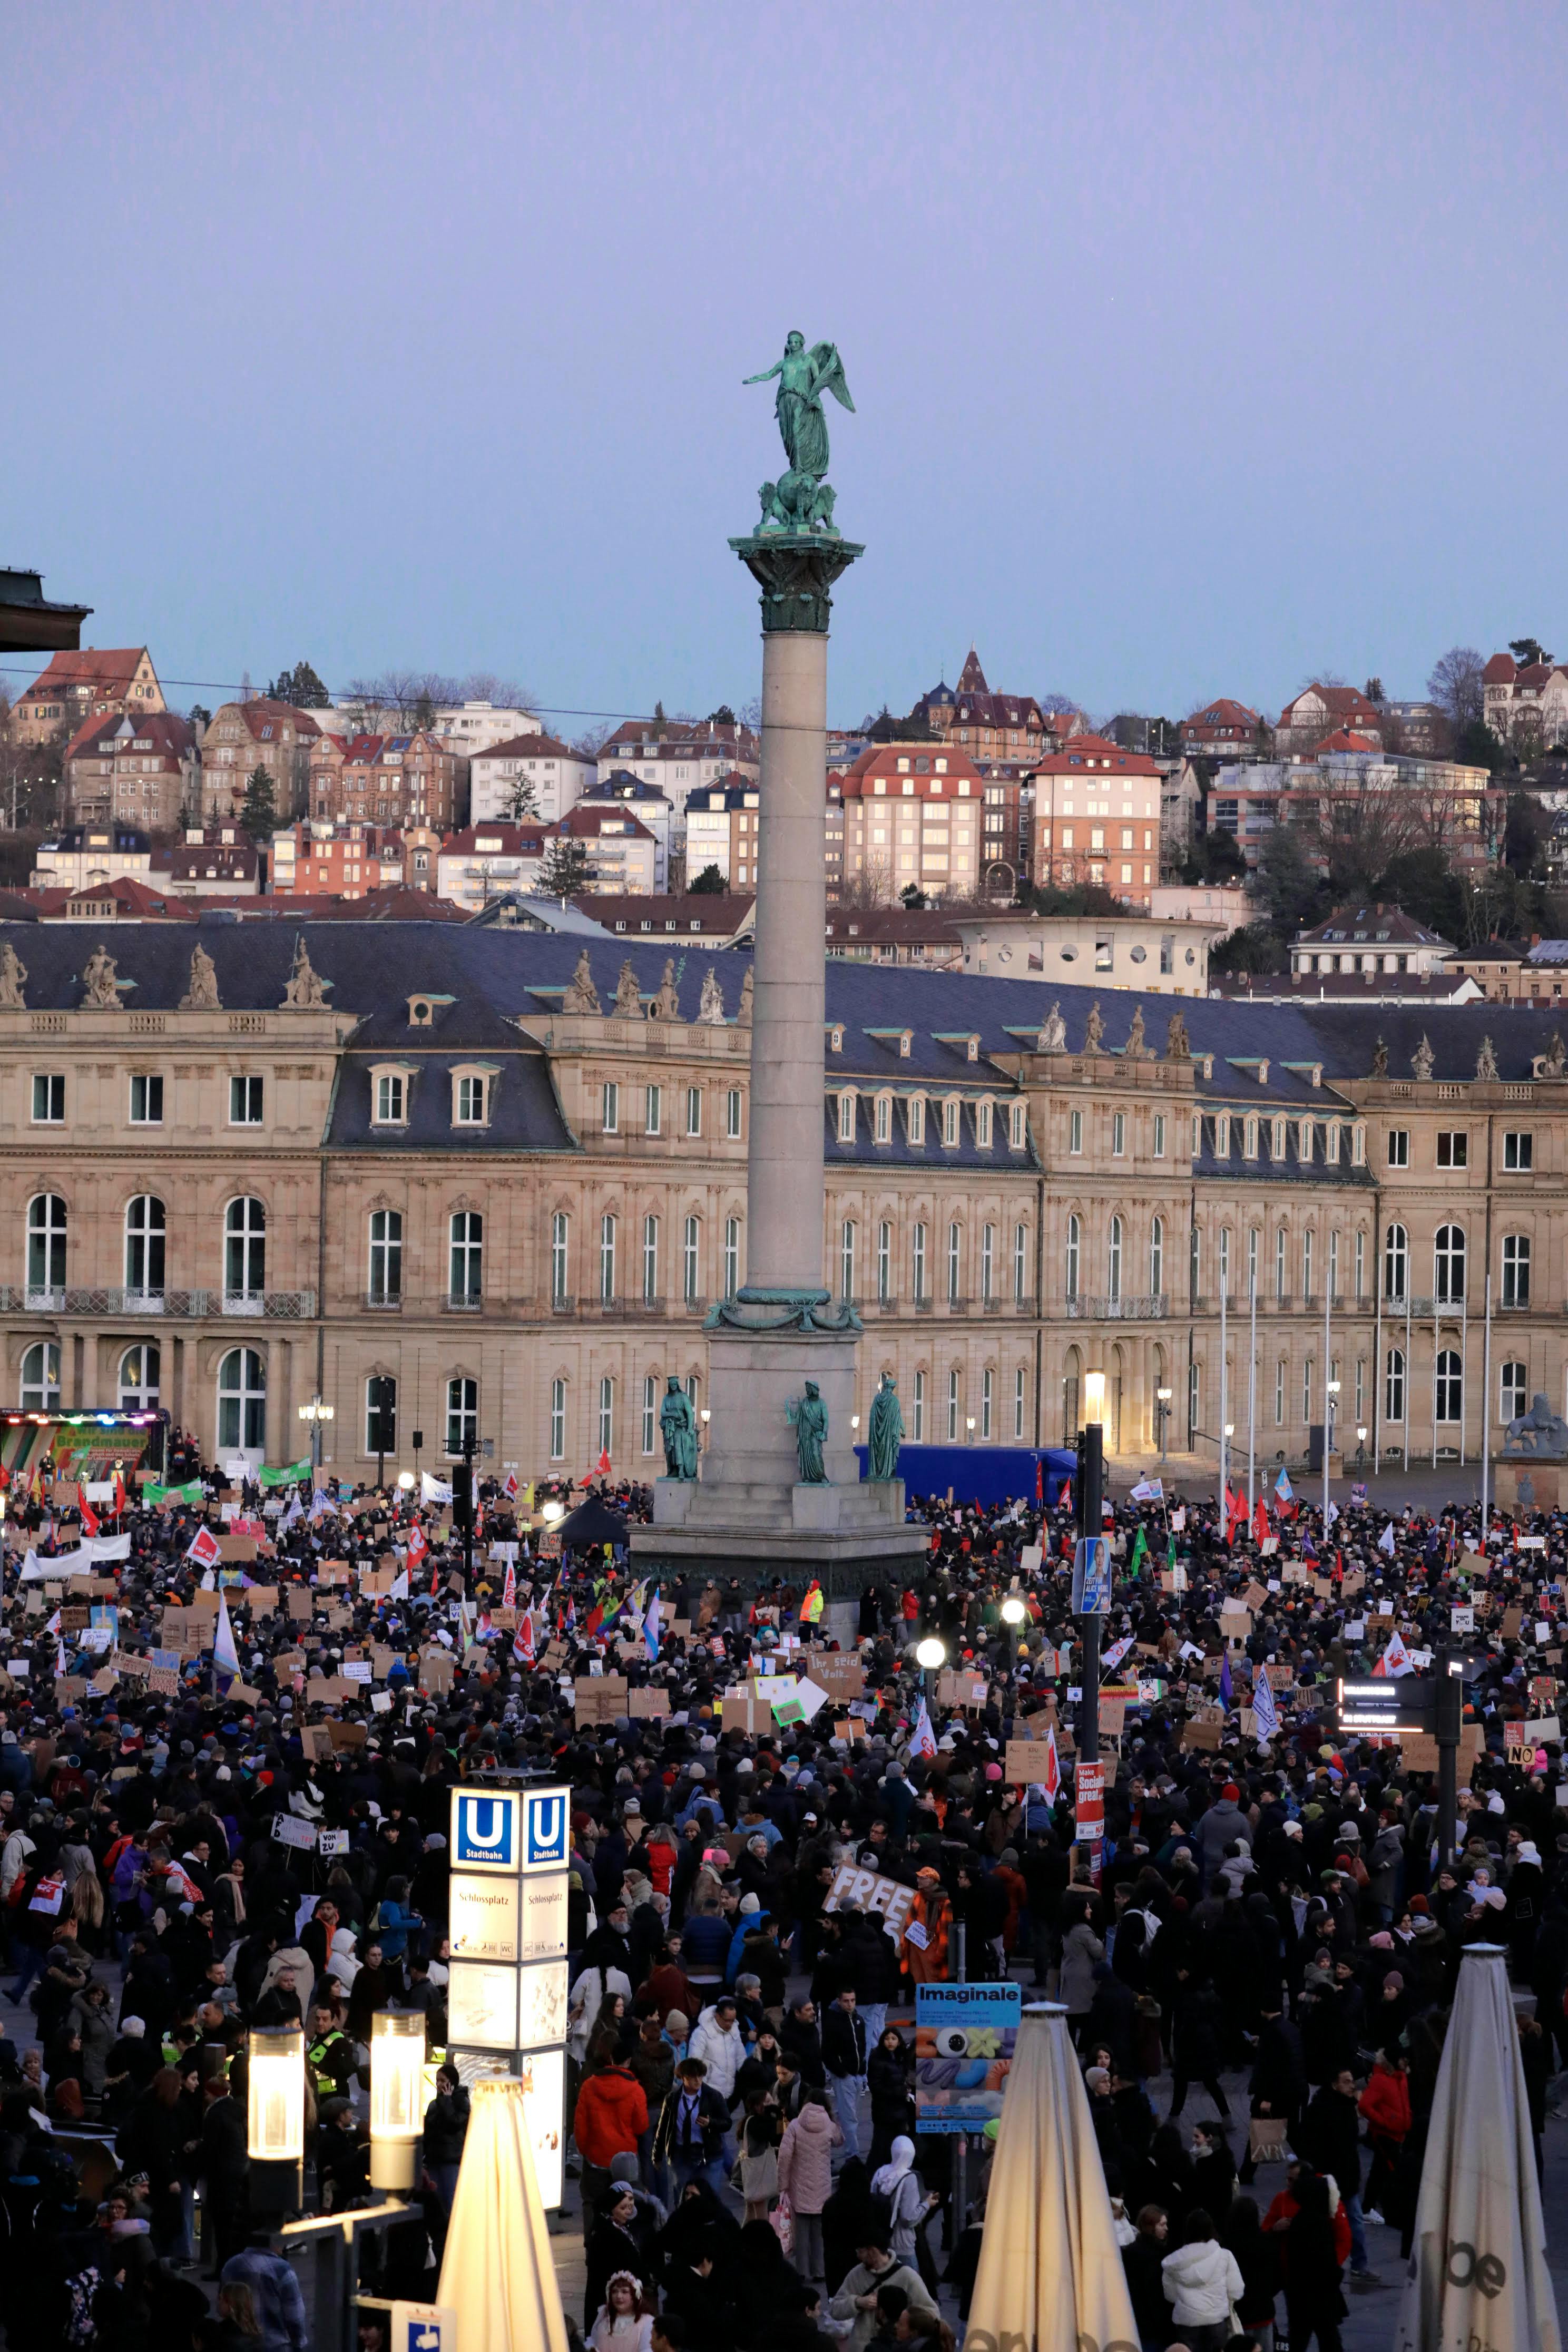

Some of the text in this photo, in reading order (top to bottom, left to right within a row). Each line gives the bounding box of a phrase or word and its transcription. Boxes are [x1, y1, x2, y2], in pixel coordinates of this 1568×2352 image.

[57, 1436, 146, 1447] Brandmauer
[811, 1654, 827, 1669] Ihr
[152, 1668, 177, 1677] SCHADEN
[1511, 1746, 1532, 1763] NO
[1079, 1789, 1099, 1804] great
[466, 1799, 503, 1848] U
[534, 1799, 560, 1847] U
[322, 1843, 334, 1851] ZU
[466, 1848, 503, 1860] Stadtbahn
[533, 1850, 559, 1860] Stadtbahn
[459, 1892, 509, 1906] Schlossplatz
[528, 1893, 563, 1905] Schlossplatz
[834, 1865, 914, 1922] FREE
[920, 1987, 1018, 2003] Imaginale
